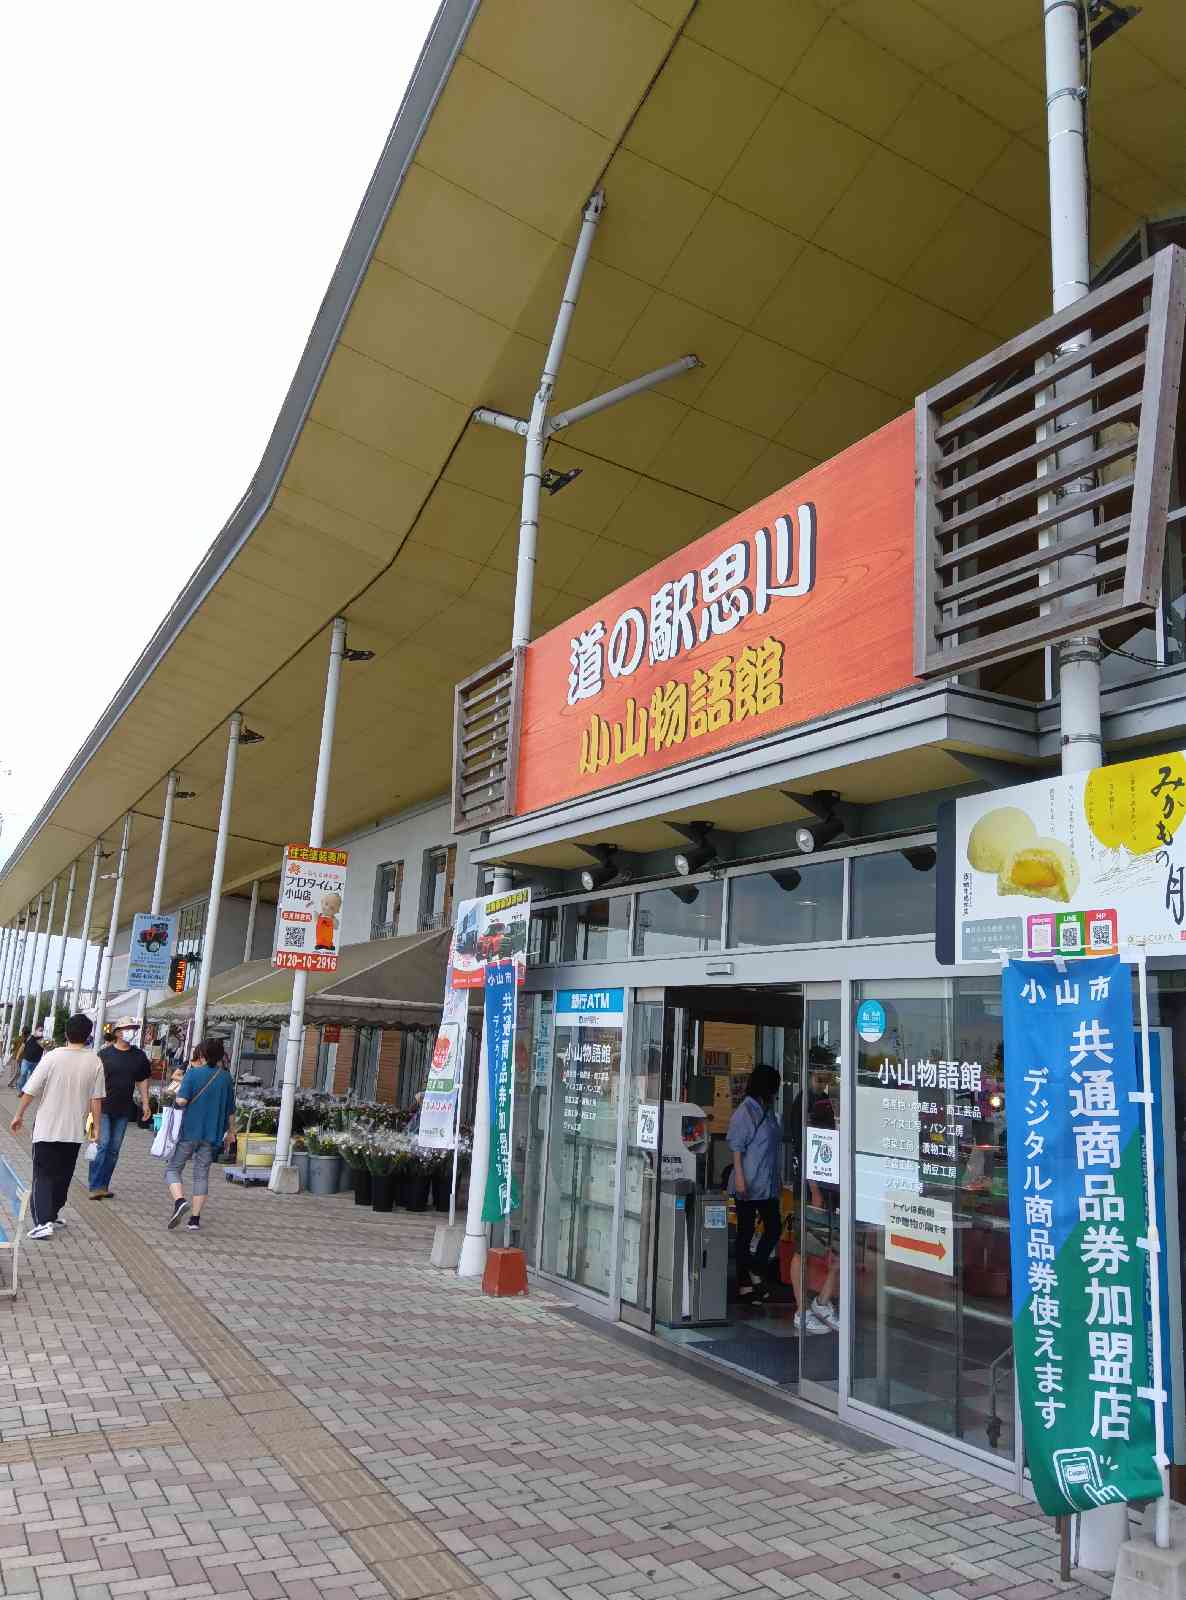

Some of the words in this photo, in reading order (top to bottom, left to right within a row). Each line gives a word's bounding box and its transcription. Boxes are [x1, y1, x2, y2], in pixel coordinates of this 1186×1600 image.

[567, 502, 816, 706] 道の駅思川
[578, 636, 785, 774] 小山物語館
[286, 876, 344, 892] プロタイムズ
[1152, 766, 1186, 925] みかもの月
[285, 888, 312, 902] 小山店
[1020, 976, 1112, 1005] 小山市
[567, 1042, 611, 1063] 小山物語館
[878, 1058, 982, 1092] 小山物語館
[1023, 1067, 1067, 1430] デジタル商品券使えます
[1069, 1019, 1134, 1442] 共通商品券加盟店
